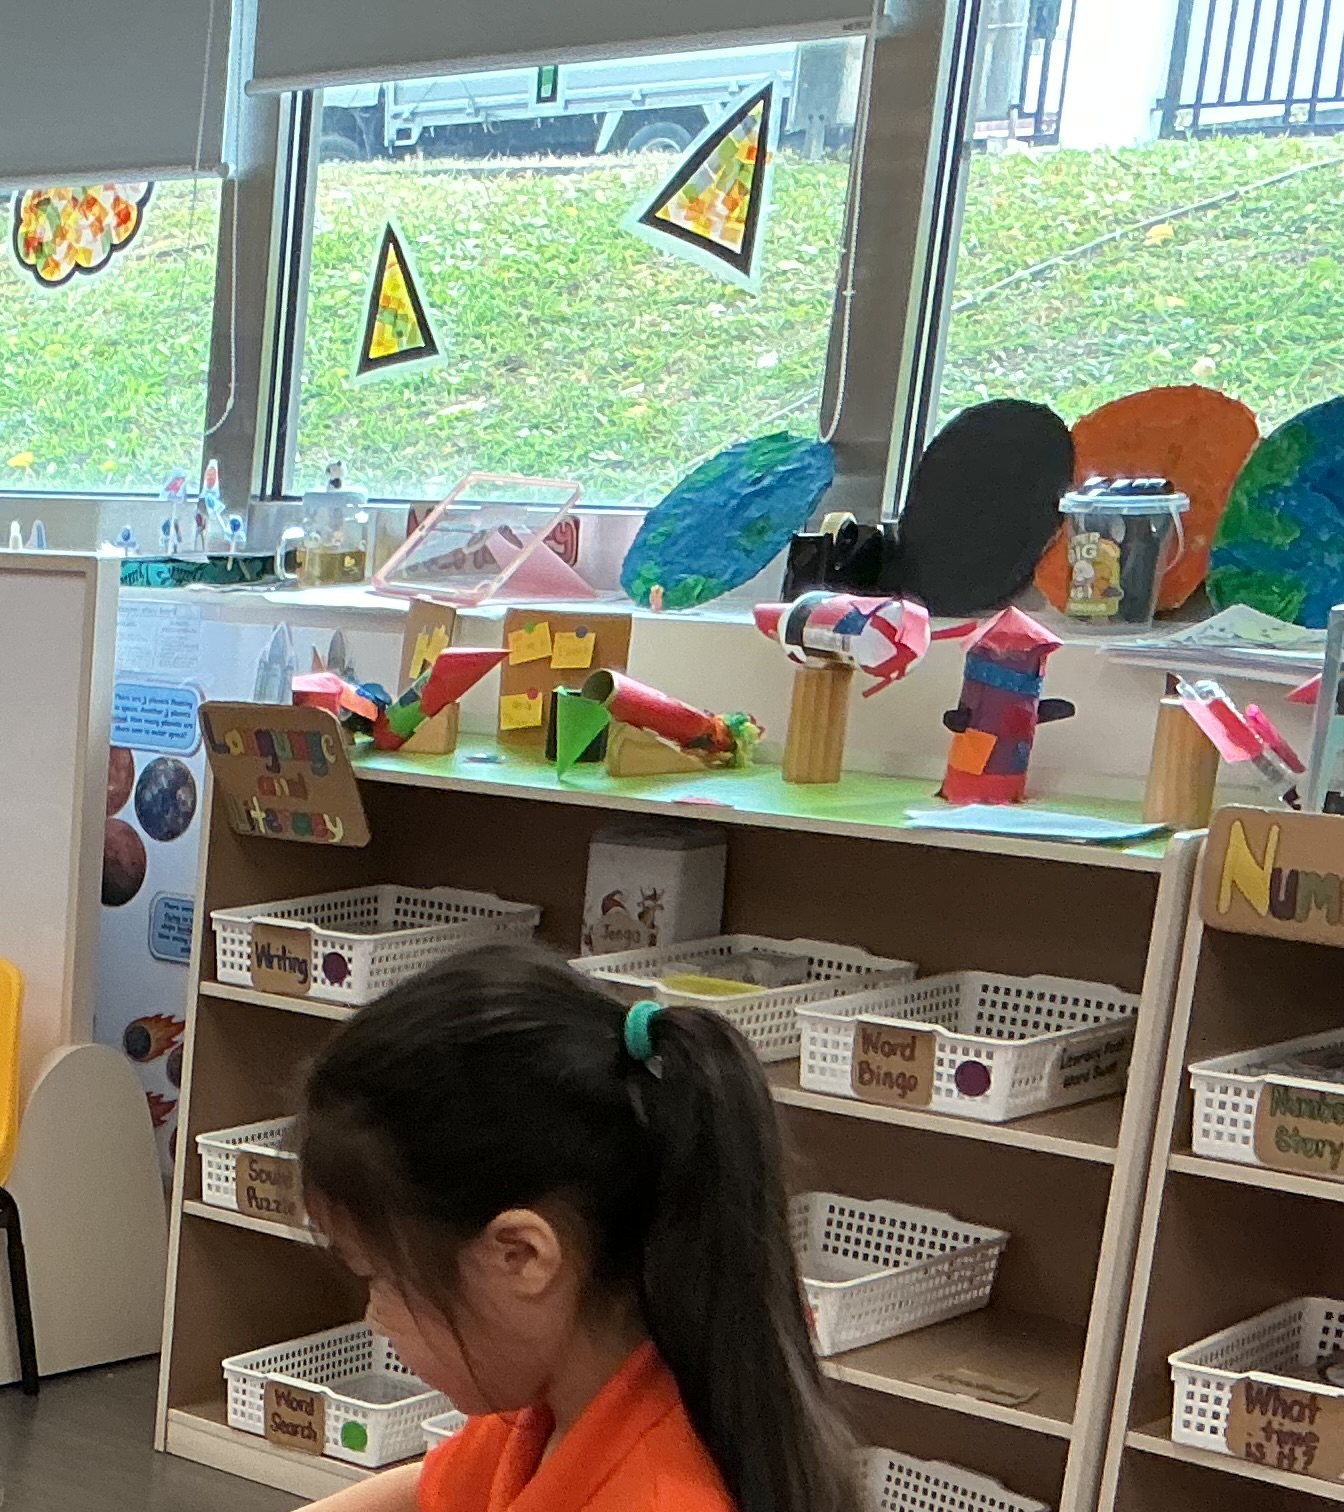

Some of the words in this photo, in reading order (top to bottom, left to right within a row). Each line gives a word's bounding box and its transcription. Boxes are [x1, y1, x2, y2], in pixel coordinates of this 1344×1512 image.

[254, 941, 309, 984] Writing
[862, 1028, 917, 1062] Word
[858, 1060, 919, 1098] Bingo
[274, 1388, 315, 1417] Word
[1244, 1381, 1323, 1426] What
[269, 1411, 318, 1442] Search
[1260, 1418, 1321, 1449] time
